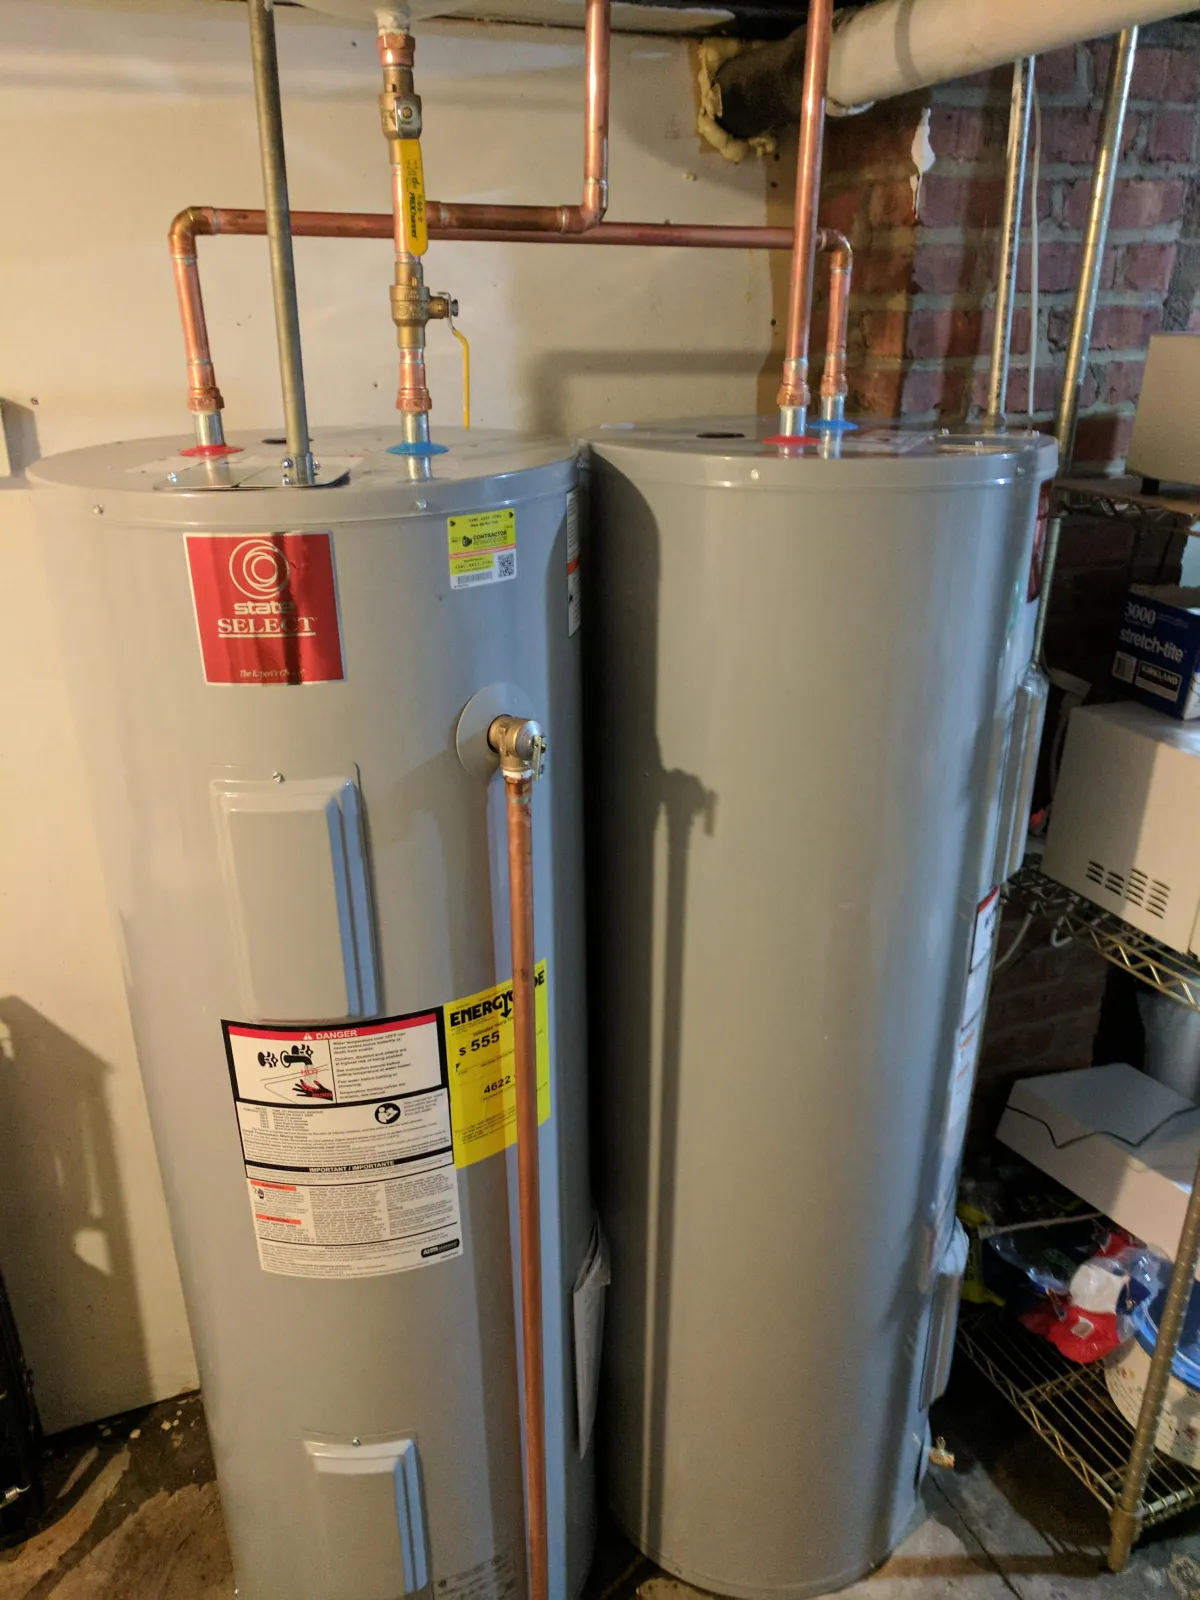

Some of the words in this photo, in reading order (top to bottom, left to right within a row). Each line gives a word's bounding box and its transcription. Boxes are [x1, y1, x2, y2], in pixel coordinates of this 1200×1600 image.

[472, 530, 508, 540] CONTRACTOR
[234, 600, 294, 615] state
[1124, 601, 1156, 624] 3000
[217, 617, 316, 633] SELECT
[316, 1030, 358, 1040] DANGER
[459, 1046, 466, 1056] $
[471, 1030, 500, 1052] 555
[484, 1075, 511, 1094] 4622
[352, 1160, 394, 1170] IMPORTANTE
